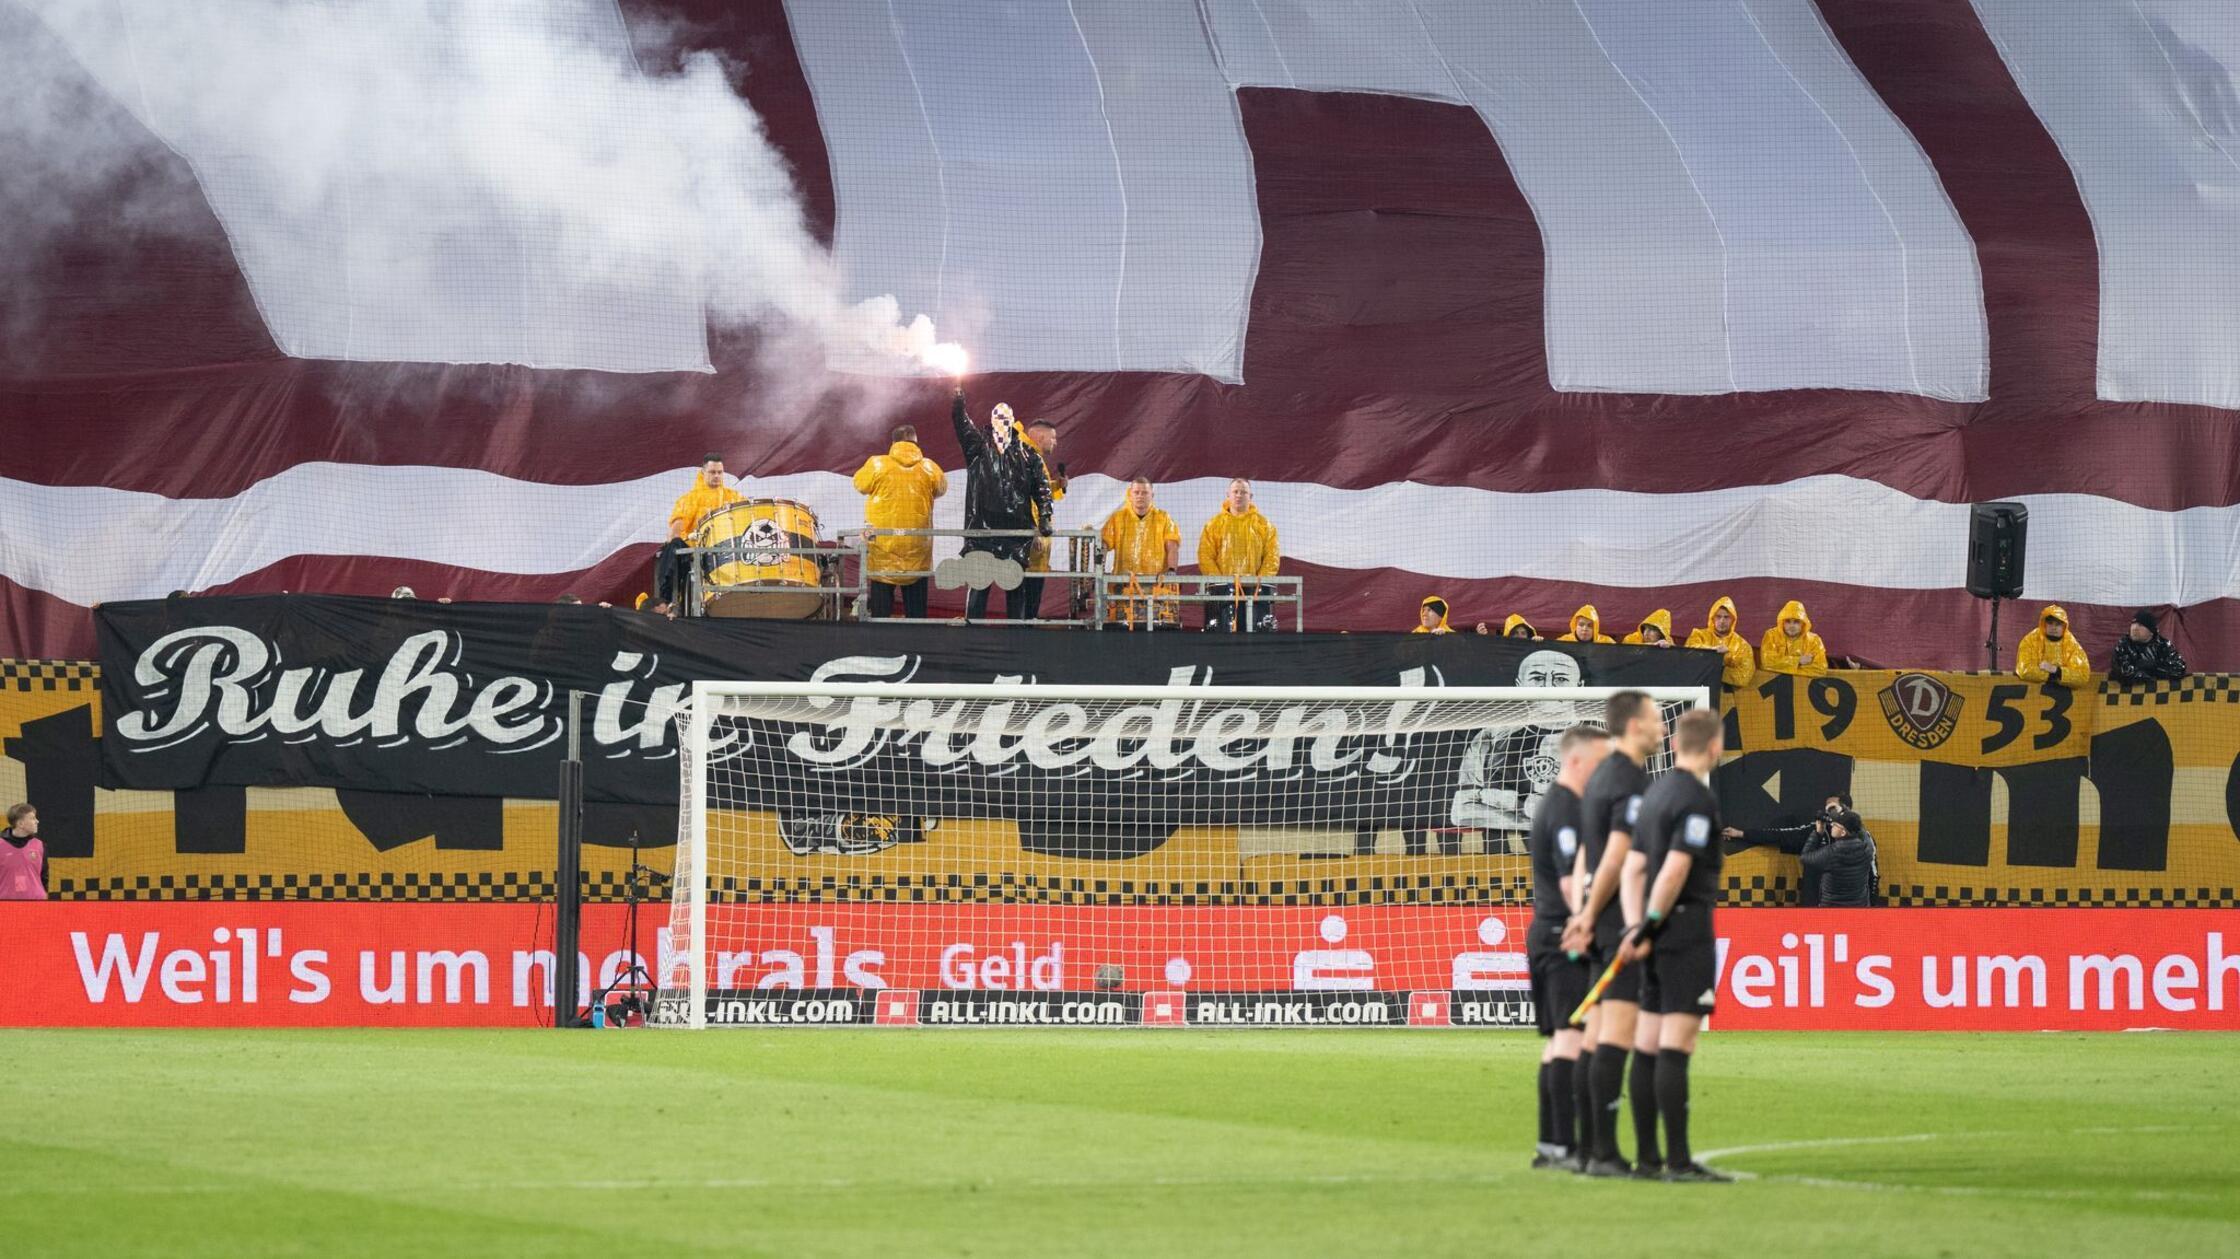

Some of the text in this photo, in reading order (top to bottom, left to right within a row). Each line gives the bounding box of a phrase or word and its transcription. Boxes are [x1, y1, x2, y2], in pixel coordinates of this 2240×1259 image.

[117, 625, 556, 750] Ruhe
[787, 655, 1430, 775] Frieden!
[1758, 673, 2073, 755] 19 53
[1889, 714, 1954, 748] DRESDEN
[70, 927, 331, 1003] Weil's
[359, 948, 490, 1004] um
[940, 942, 1063, 990] Geld
[1715, 933, 1896, 1009] eil's
[1922, 955, 2047, 1008] um
[931, 1001, 1124, 1024] ALL-INKL.COM
[1197, 1002, 1388, 1024] ALL-INKL.COM
